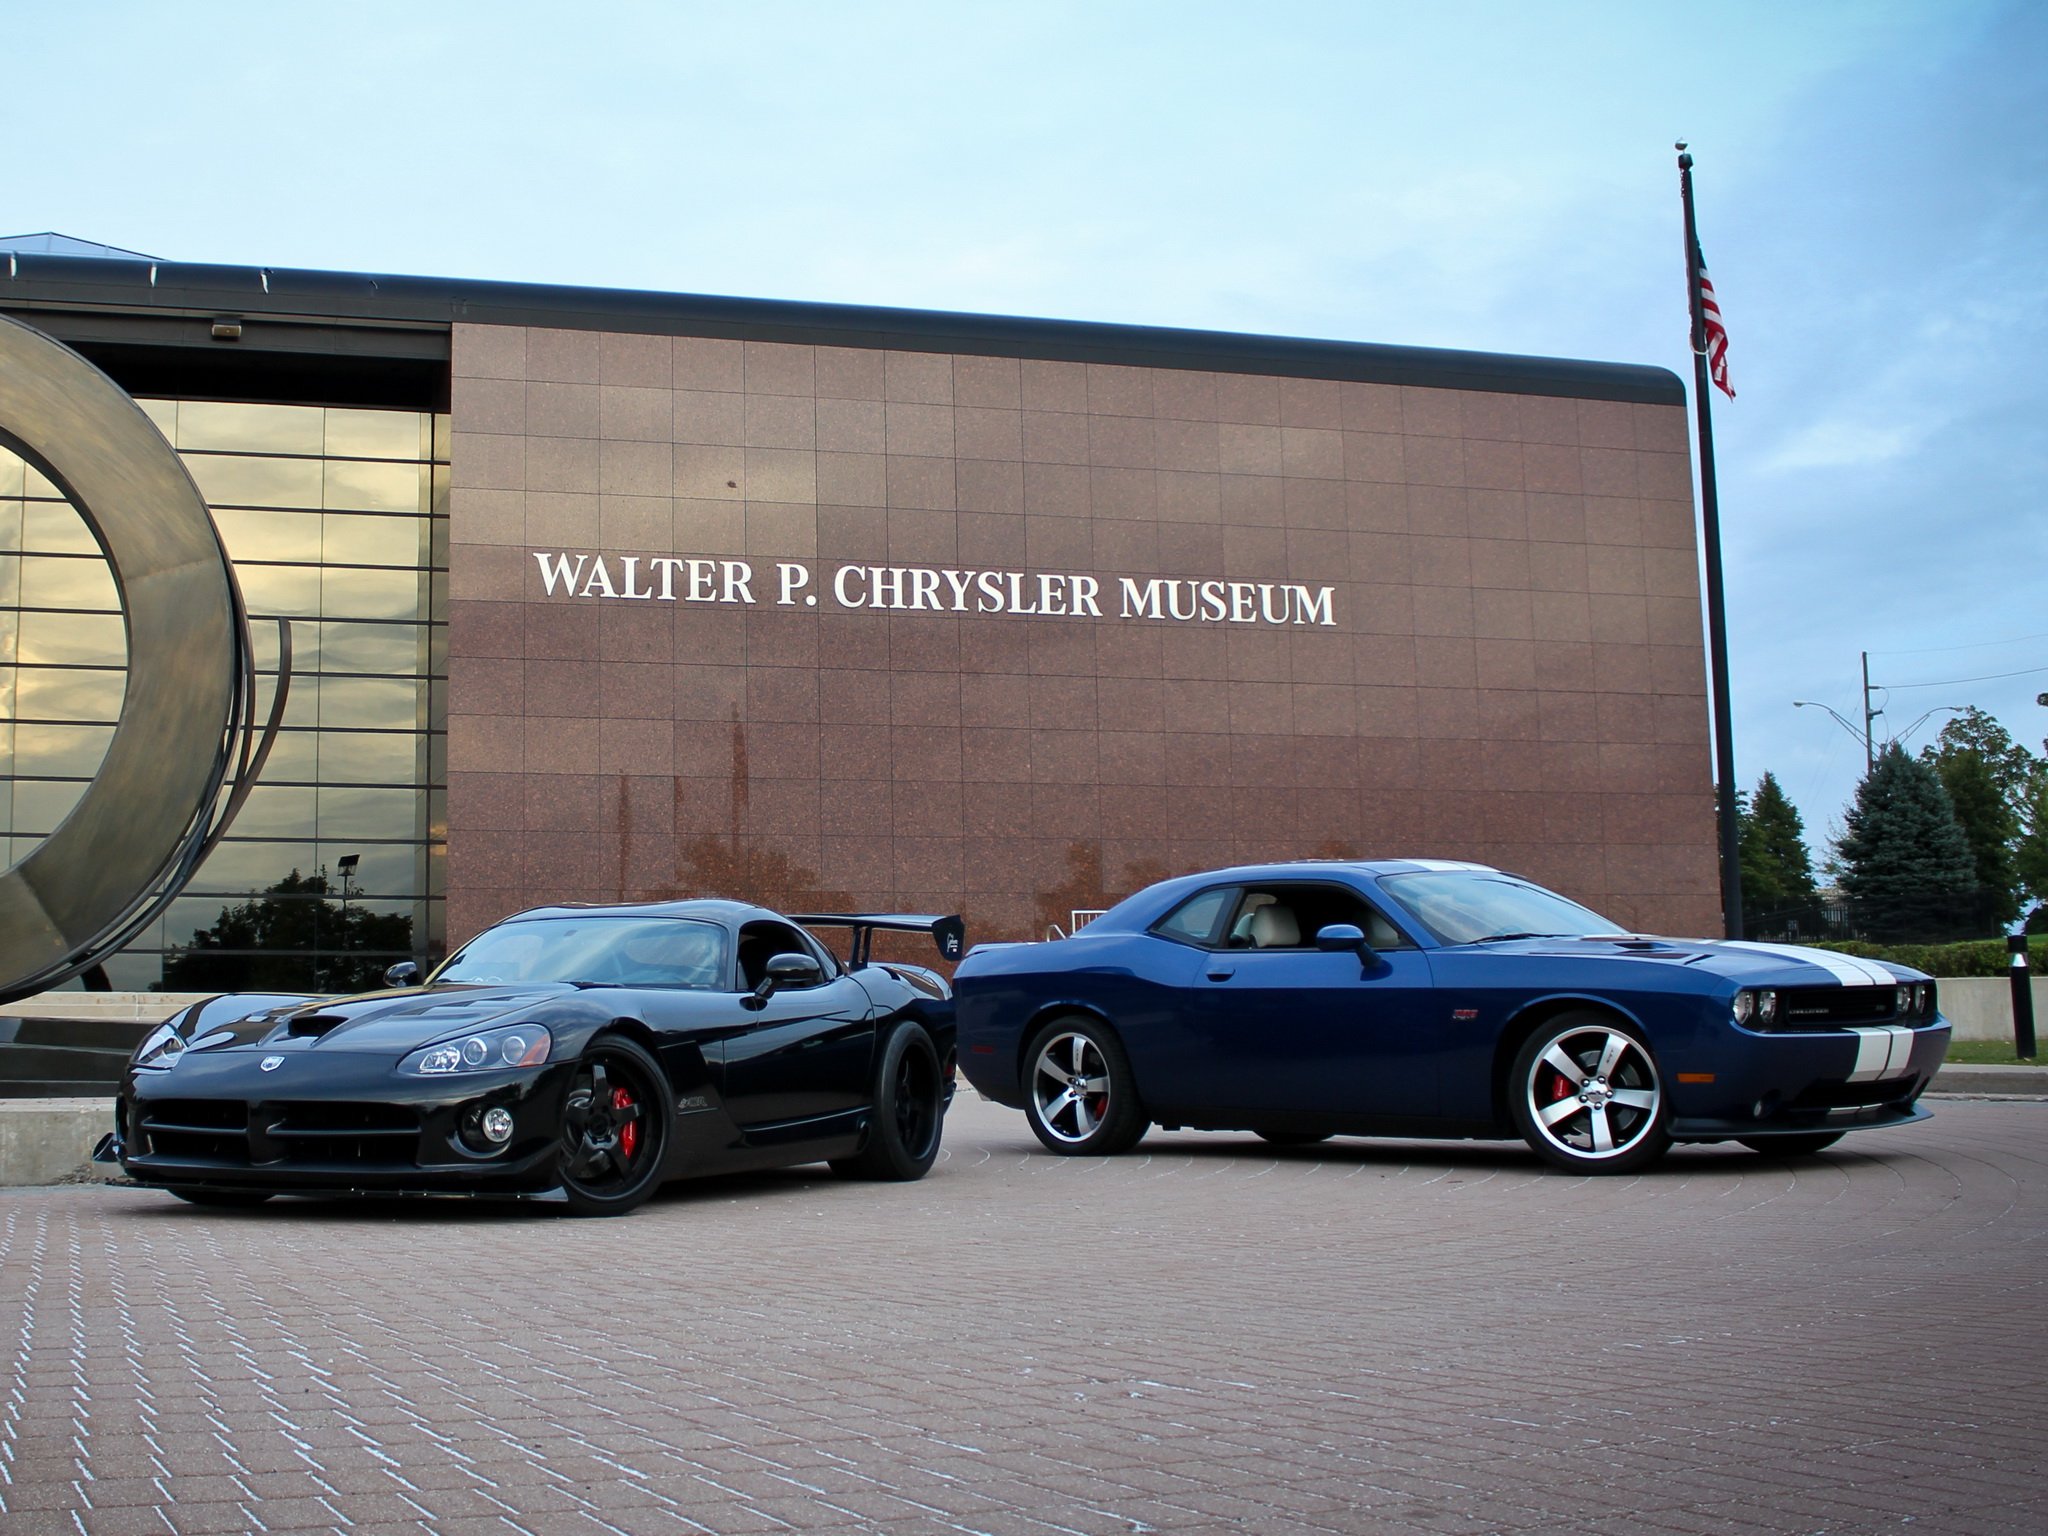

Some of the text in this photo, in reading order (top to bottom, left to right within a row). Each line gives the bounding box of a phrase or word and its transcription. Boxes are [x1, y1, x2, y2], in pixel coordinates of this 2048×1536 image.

[532, 552, 1337, 626] WALTER P. CHRYSLER MUSEUM
